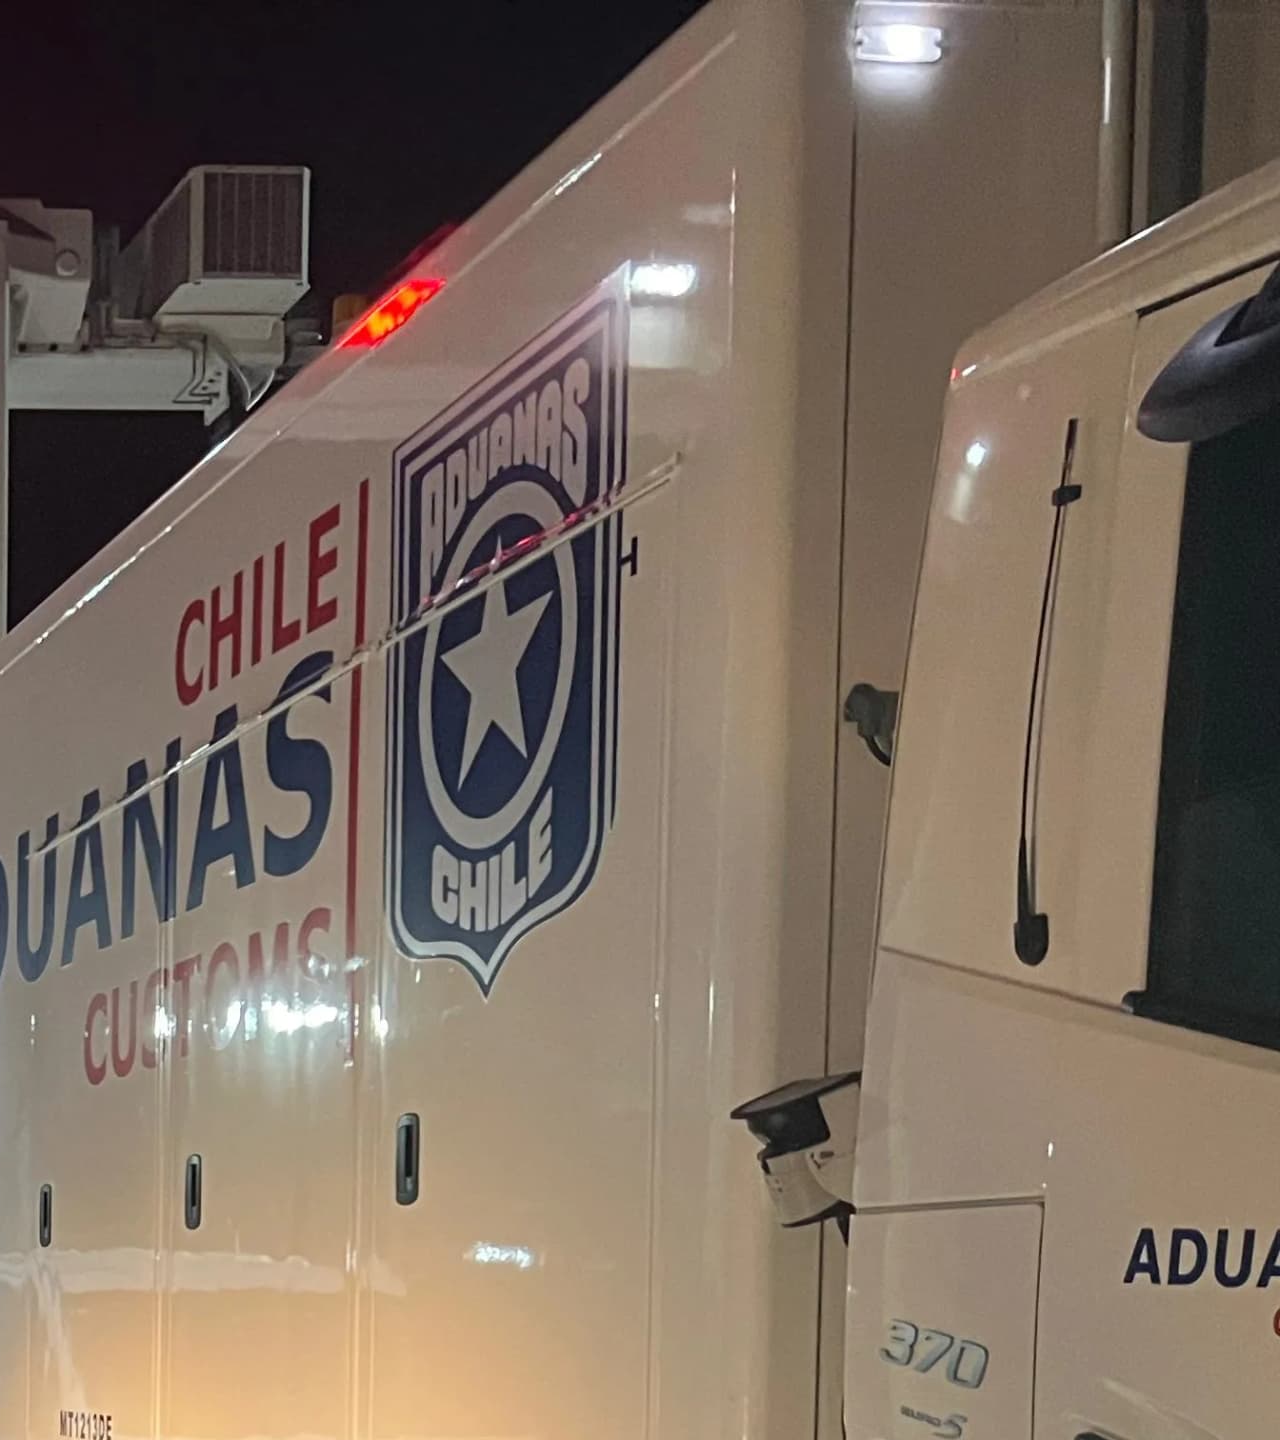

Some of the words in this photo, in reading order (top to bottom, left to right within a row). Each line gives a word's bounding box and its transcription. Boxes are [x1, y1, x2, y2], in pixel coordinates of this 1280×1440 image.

[419, 357, 590, 604] ADUANAS
[175, 503, 341, 707] CHILE
[431, 785, 553, 933] CHILE
[880, 1318, 990, 1389] 370
